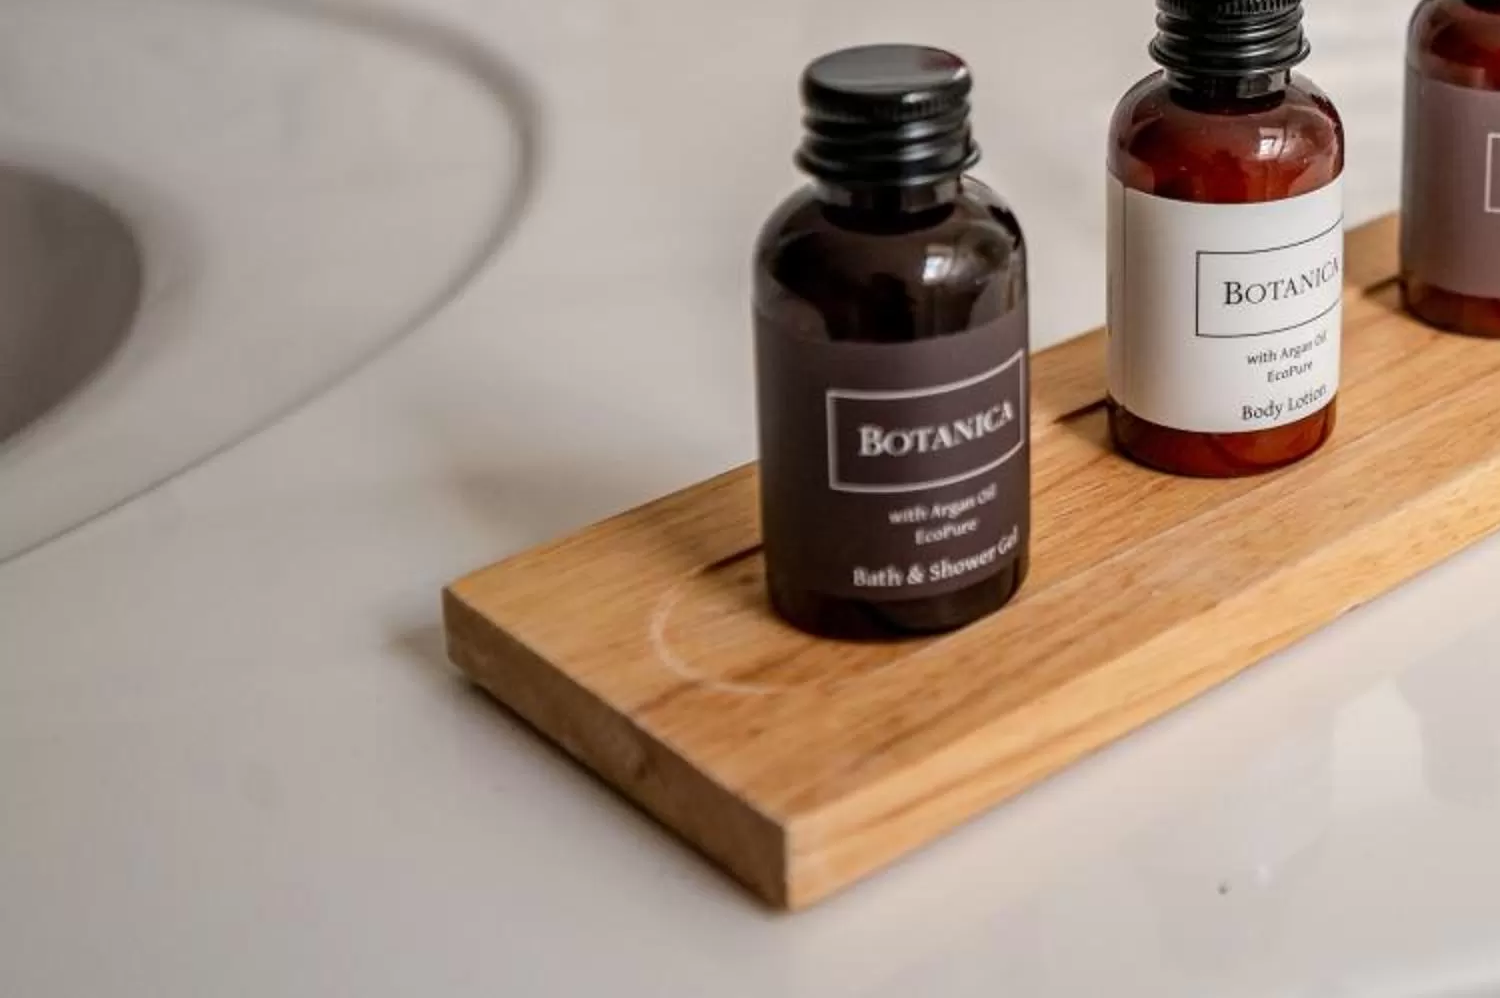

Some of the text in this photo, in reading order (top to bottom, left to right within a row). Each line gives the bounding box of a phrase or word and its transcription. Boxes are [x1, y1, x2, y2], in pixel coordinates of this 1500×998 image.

[1247, 330, 1328, 366] with Argan Oil
[1267, 361, 1312, 382] EcoPure
[1241, 384, 1327, 421] Body Lotion
[859, 401, 1013, 456] BOTANICA
[888, 483, 997, 525] with Argan Oil
[915, 519, 977, 545] EcoPure
[852, 525, 1018, 587] Bath & Shower Gel
